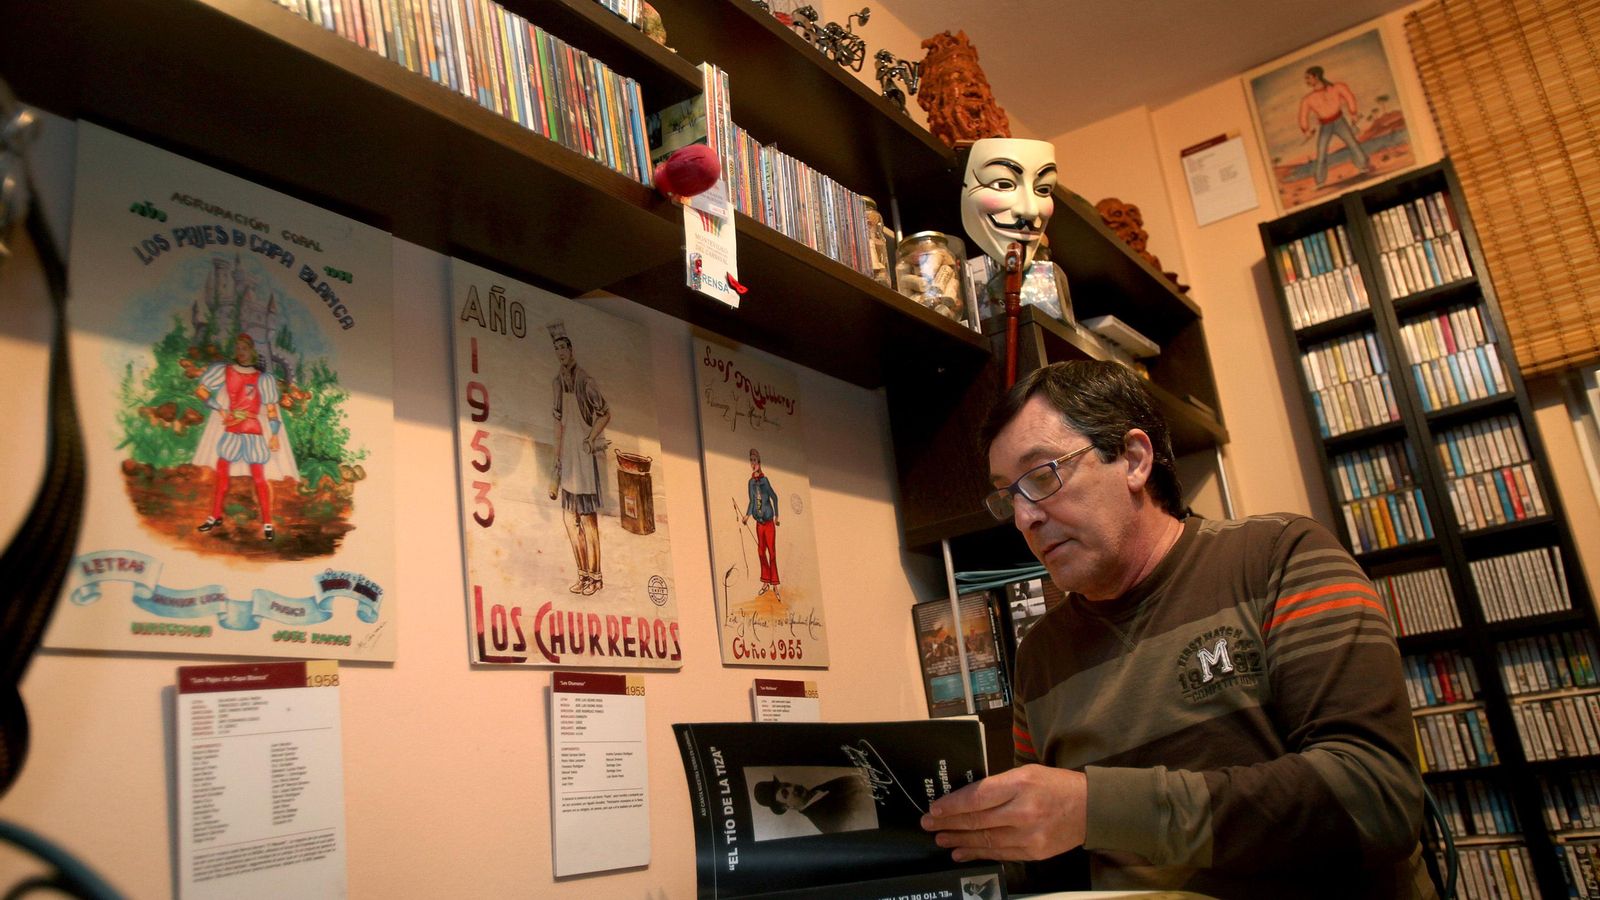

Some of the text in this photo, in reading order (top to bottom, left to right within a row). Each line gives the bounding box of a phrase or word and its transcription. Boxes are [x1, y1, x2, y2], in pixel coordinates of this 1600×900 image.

[132, 233, 171, 266] LOS
[249, 233, 295, 268] CAPA
[298, 264, 355, 331] BLANCA
[701, 273, 730, 294] RENSA
[461, 284, 527, 339] AÑO
[82, 556, 145, 576] LETRAS
[534, 600, 683, 664] CHURREROS
[769, 639, 803, 661] 1955
[1196, 638, 1234, 684] M
[307, 674, 340, 688] 1958
[626, 686, 646, 697] 1953
[719, 778, 731, 794] LA
[721, 797, 734, 815] DE
[723, 819, 737, 844] TÍO
